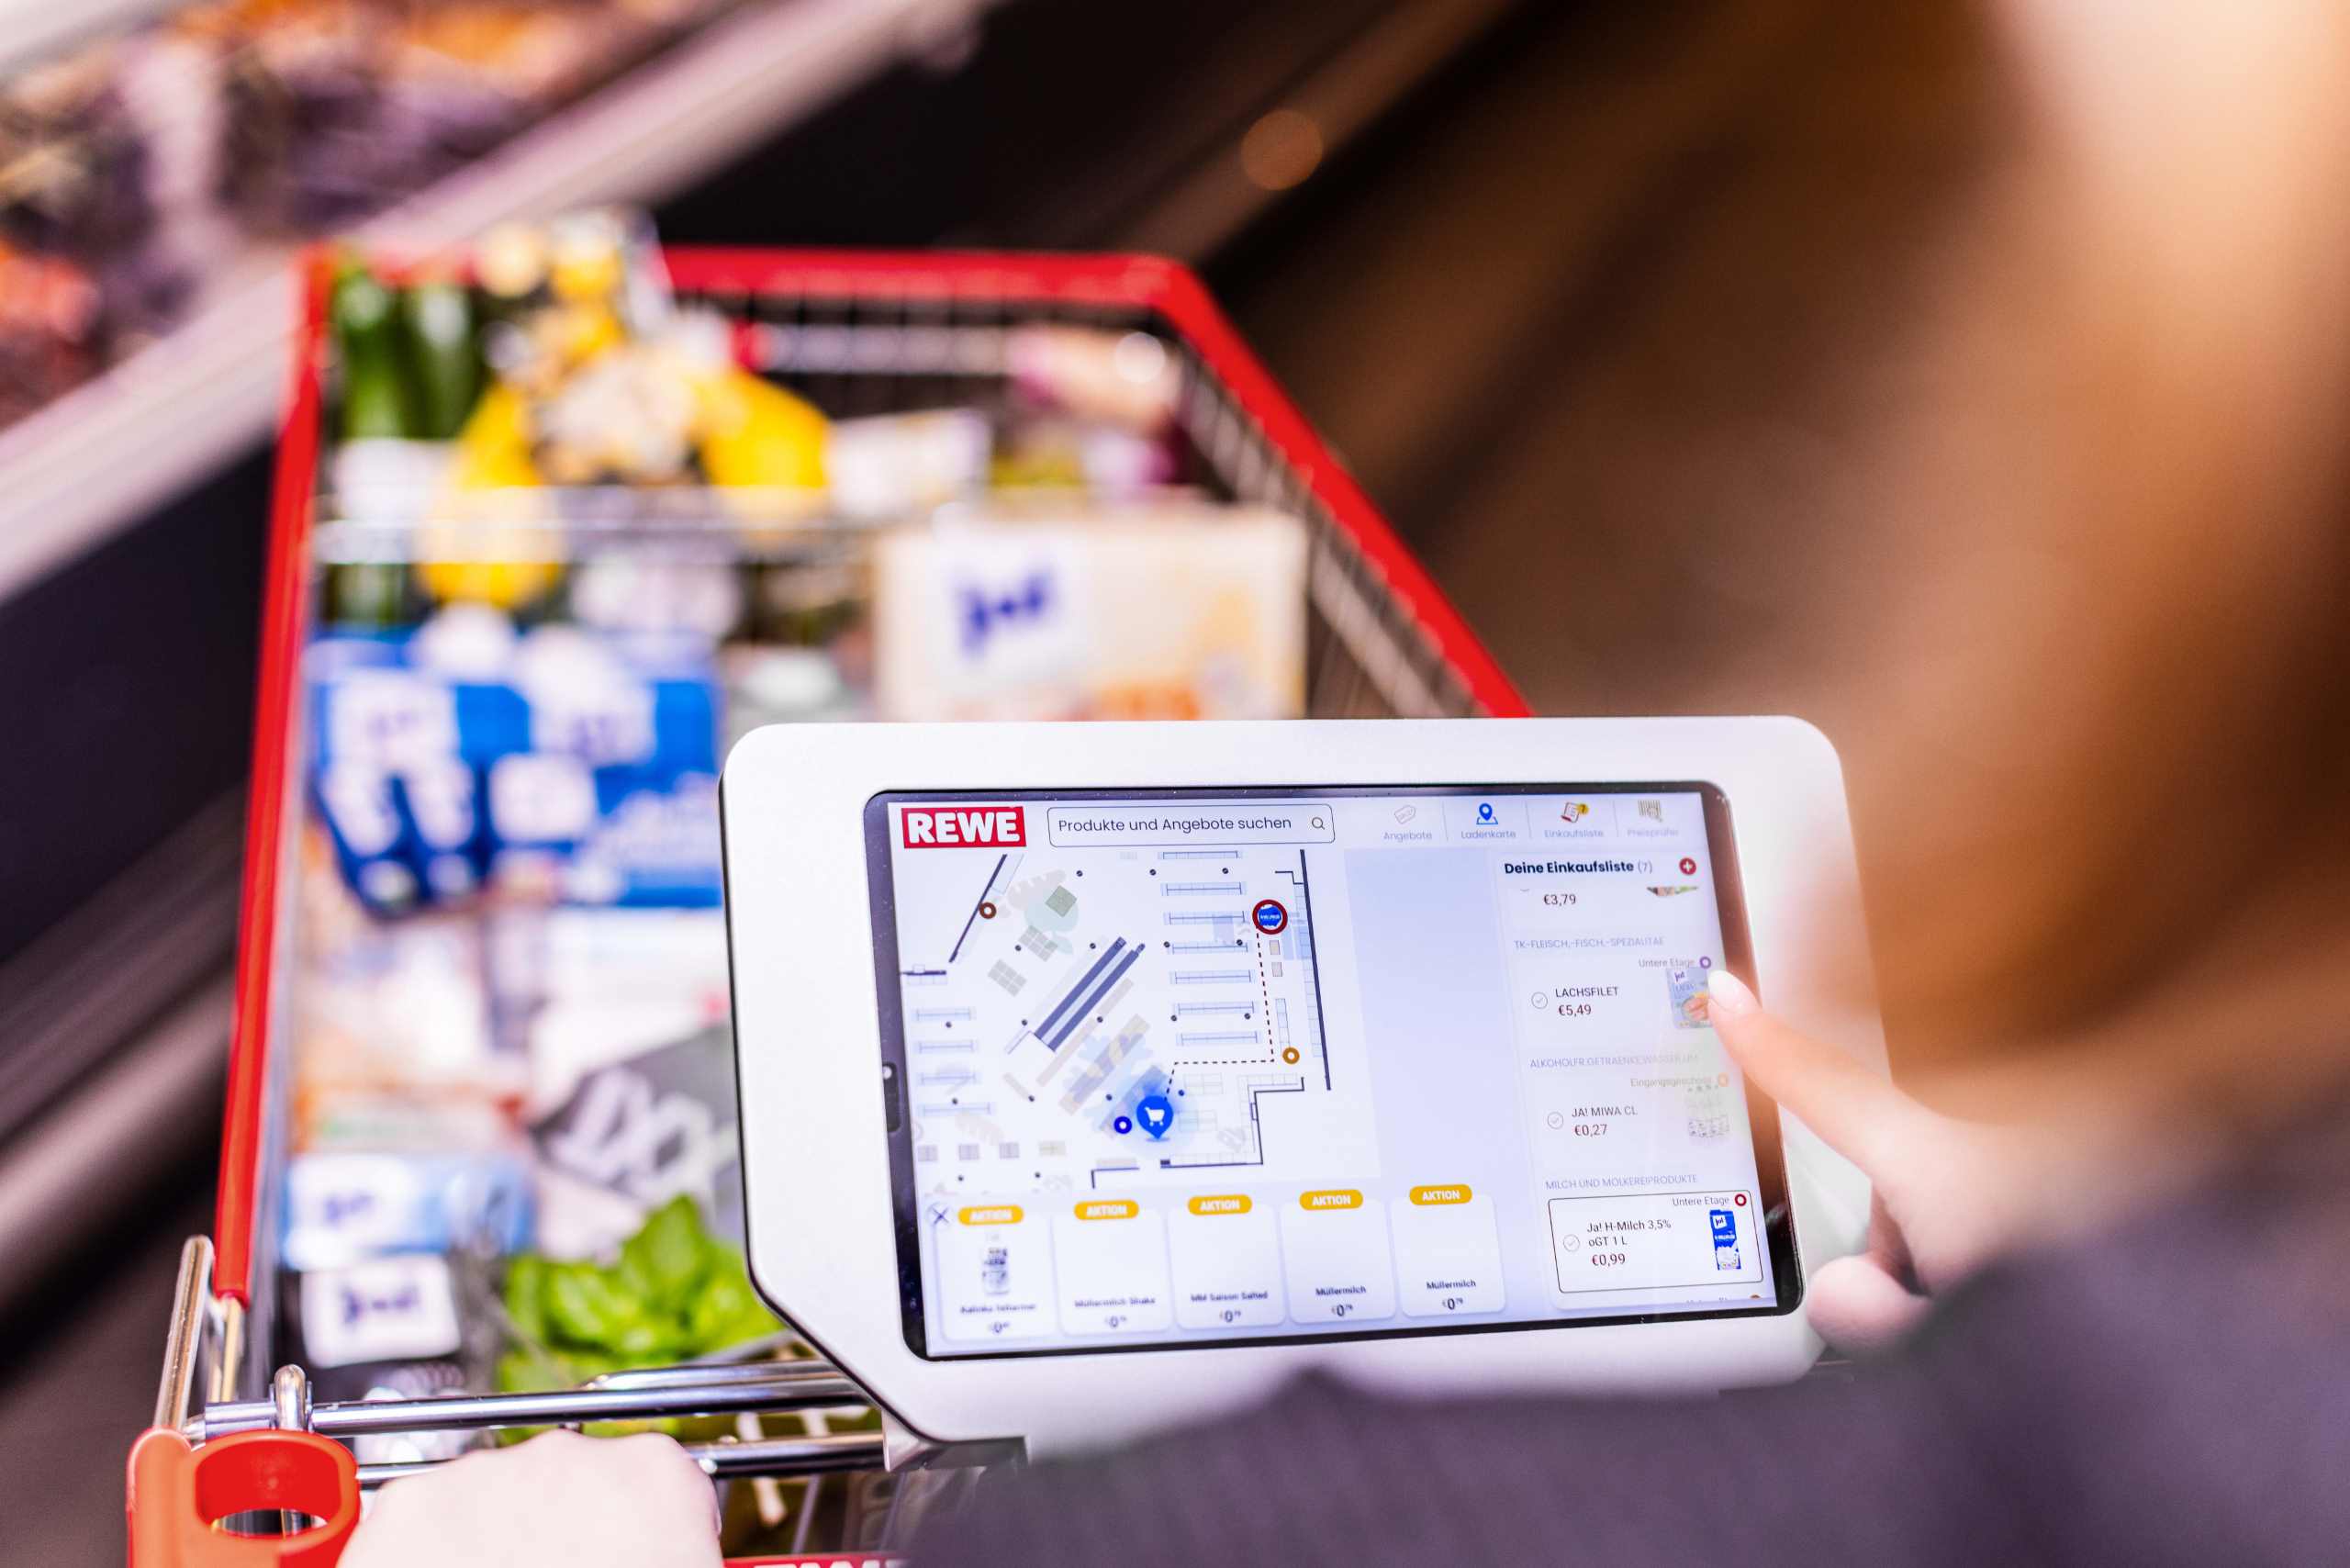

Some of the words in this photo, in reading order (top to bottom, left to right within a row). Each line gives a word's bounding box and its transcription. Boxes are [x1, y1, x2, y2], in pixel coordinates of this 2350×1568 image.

[907, 812, 1020, 844] REWE
[1058, 818, 1125, 832] Produkte
[1129, 818, 1158, 831] und
[1162, 817, 1234, 834] Angebote
[1237, 817, 1292, 830] suchen
[1383, 831, 1433, 842] Angebote
[1461, 829, 1516, 839] Ladenkarte
[1544, 828, 1604, 838] Einkaufsliste
[1505, 861, 1544, 874] Deine
[1547, 860, 1634, 873] Einkaufsliste
[1638, 860, 1653, 874] (7)
[1543, 893, 1577, 907] €3,79
[1639, 958, 1667, 968] Untere
[1555, 986, 1619, 998] LACHSFILET
[1558, 1003, 1592, 1017] €5,49
[1572, 1107, 1588, 1118] JA!
[1591, 1106, 1622, 1117] MIWA
[1625, 1105, 1639, 1116] CL
[1574, 1123, 1607, 1137] €0,27
[1545, 1180, 1577, 1191] MILCH
[1579, 1178, 1600, 1189] UND
[1602, 1174, 1697, 1188] MOLKEREIPRODUKTE
[1312, 1194, 1351, 1206] AKTION
[1423, 1191, 1461, 1202] AKTION
[1673, 1196, 1700, 1207] Untere
[1704, 1195, 1729, 1207] Etage
[1200, 1200, 1240, 1212] AKTION
[1587, 1222, 1603, 1234] Ja!
[1605, 1219, 1645, 1232] H-Milch
[1648, 1219, 1672, 1231] 3,5%
[1588, 1236, 1608, 1248] oGT
[1620, 1236, 1628, 1246] L
[1592, 1253, 1626, 1267] €0,99
[1315, 1285, 1367, 1296] Müllermilch
[1427, 1279, 1477, 1291] Müllermilch
